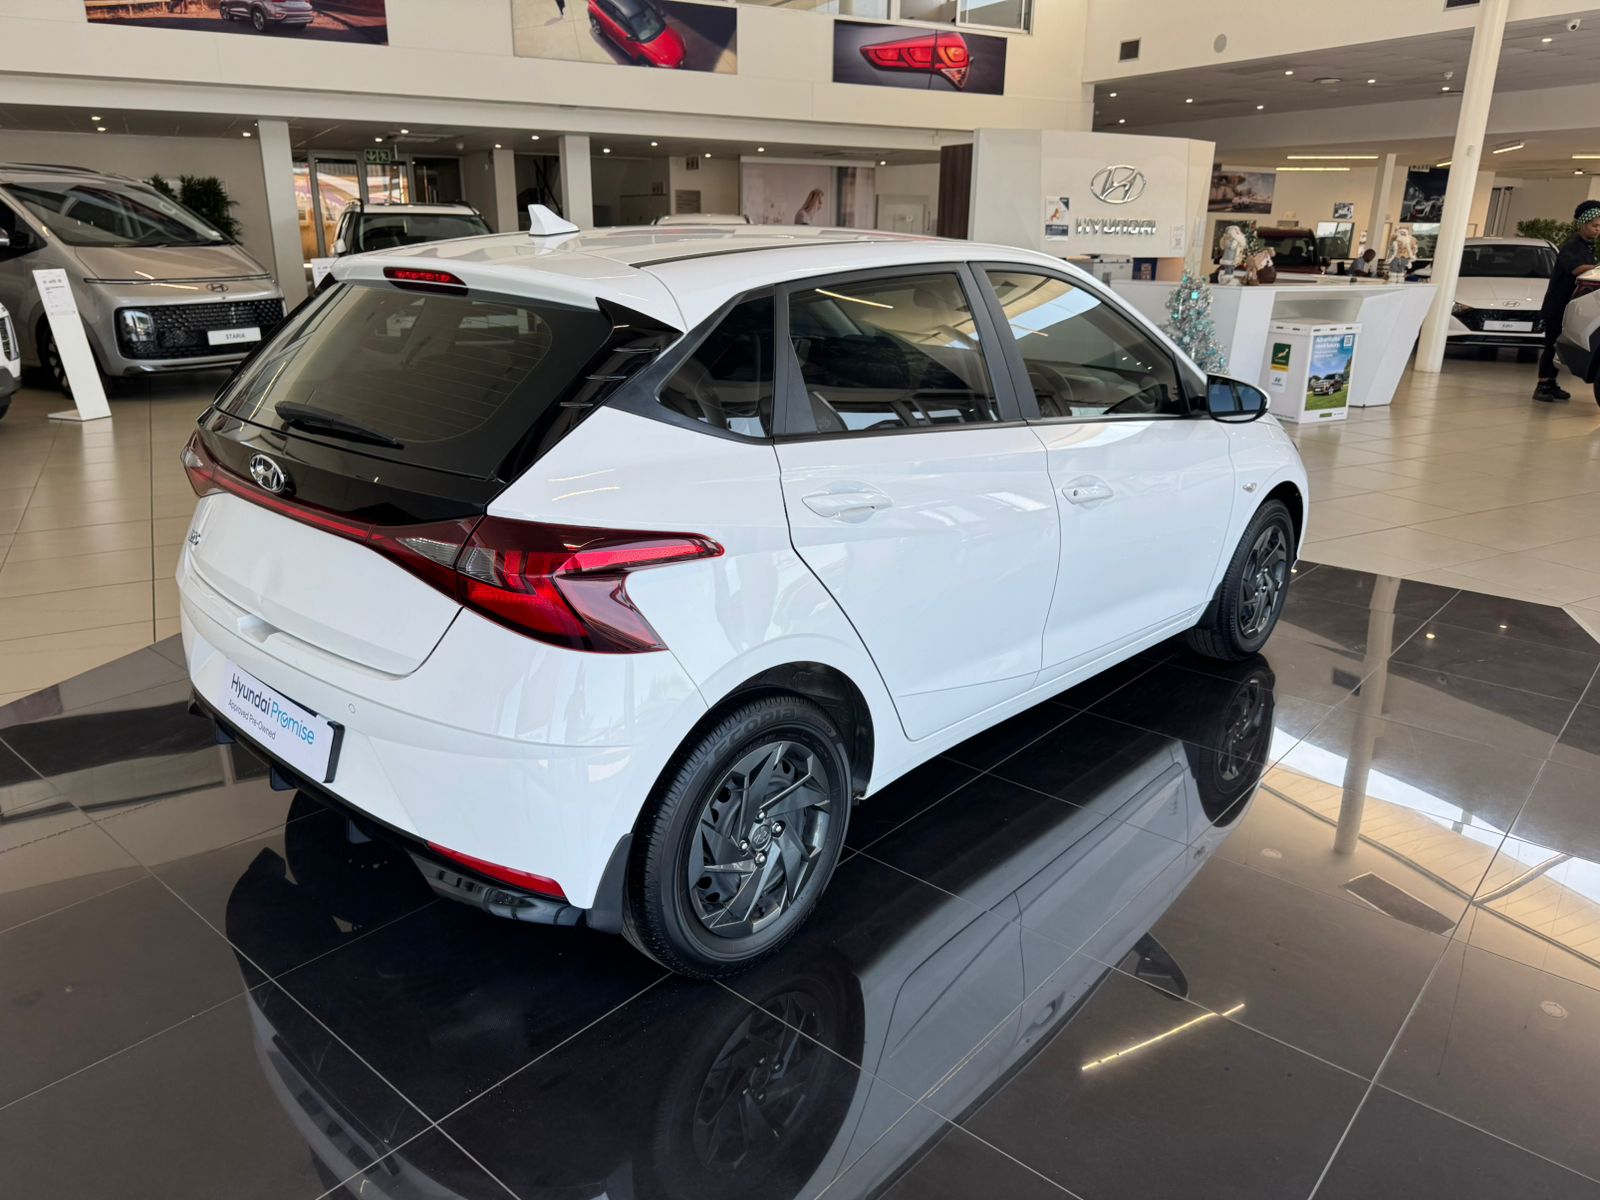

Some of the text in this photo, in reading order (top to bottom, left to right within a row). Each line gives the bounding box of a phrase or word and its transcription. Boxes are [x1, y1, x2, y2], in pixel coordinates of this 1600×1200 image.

[1076, 218, 1157, 236] HYUNDAI
[228, 699, 277, 741] Approved Pre-Owned
[230, 673, 315, 745] Hyundai Promise
